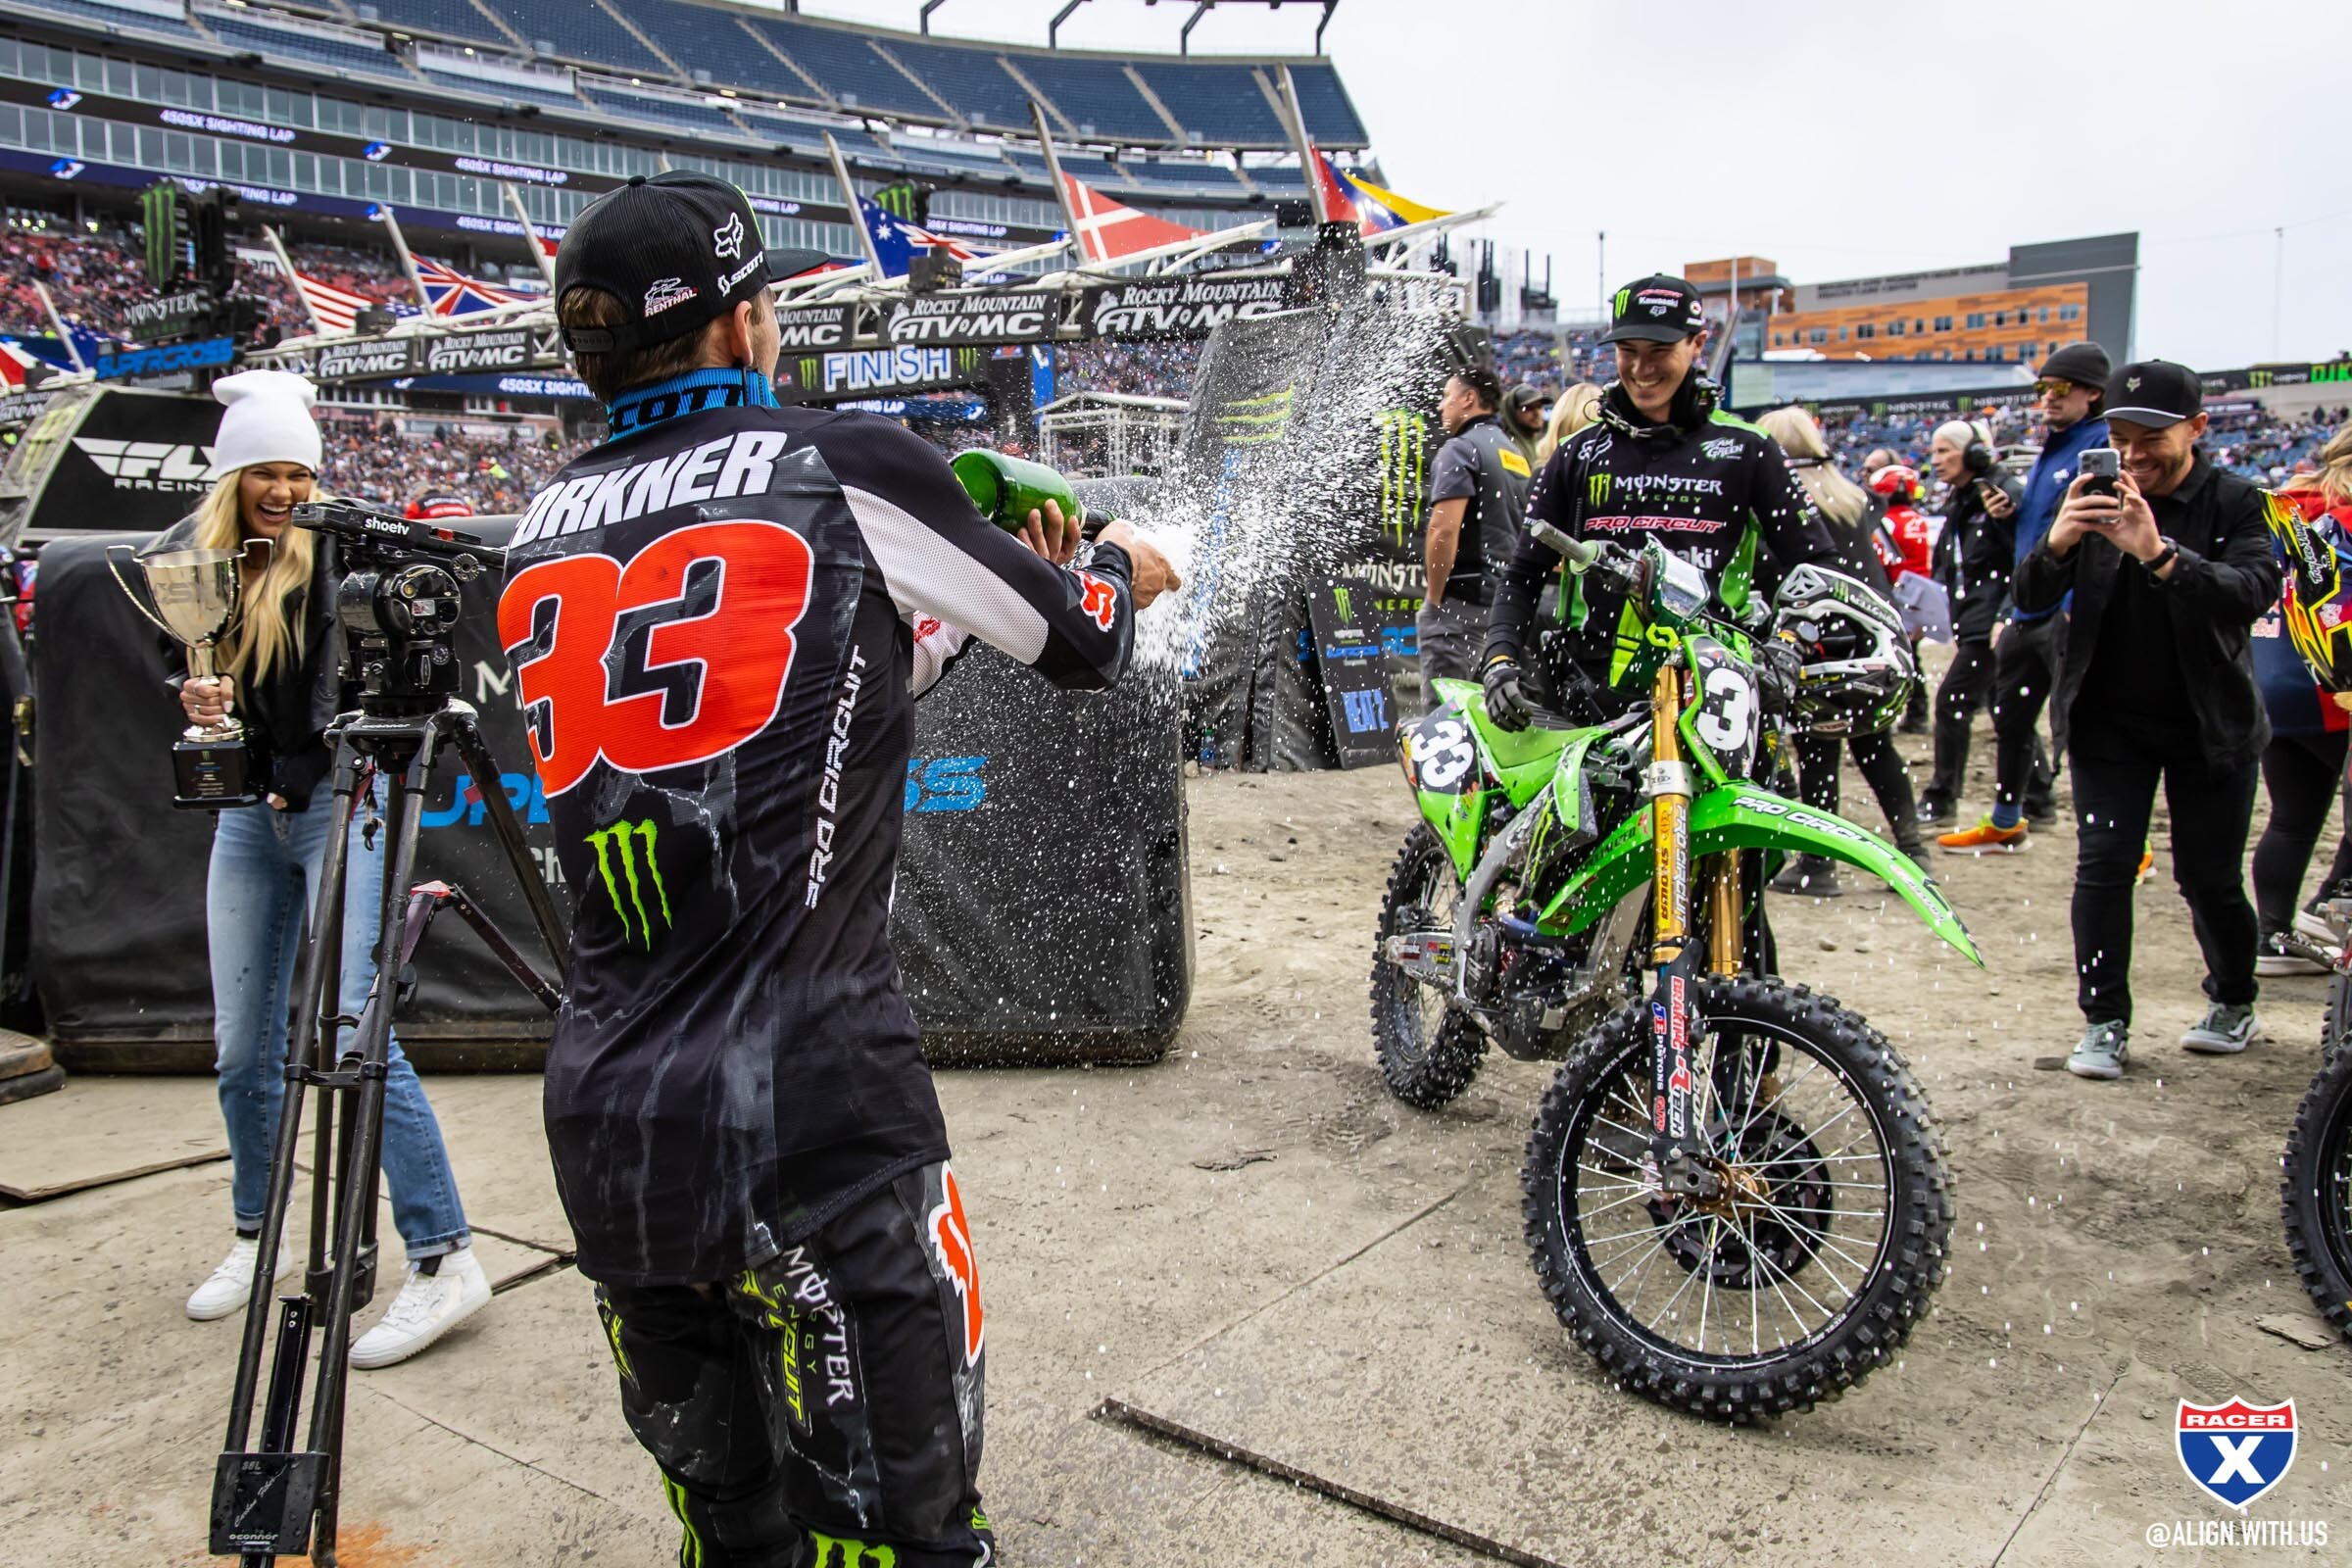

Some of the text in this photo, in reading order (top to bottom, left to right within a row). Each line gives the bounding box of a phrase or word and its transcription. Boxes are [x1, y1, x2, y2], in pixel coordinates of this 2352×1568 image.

[160, 109, 296, 143] 450SX SIGHTING LAP
[491, 162, 545, 182] SIGHTING
[545, 170, 568, 184] LAP
[270, 190, 298, 206] LAP
[780, 203, 801, 215] LAP
[948, 221, 989, 236] SIGHTING
[989, 225, 1008, 238] LAP
[644, 289, 698, 318] RENTHAL
[1121, 279, 1285, 306] ROCKY MOUNTAIN
[123, 292, 199, 326] MONSTER
[912, 294, 1048, 317] ROCKY MOUNTAIN
[332, 339, 408, 358] ROCKY MOUNTAIN
[444, 331, 526, 351] ROCKY MOUNTAIN
[824, 345, 952, 392] FINISH
[499, 377, 544, 394] 450SX
[885, 400, 906, 413] LAP
[1615, 474, 1723, 496] MONSTER
[365, 516, 410, 535] shoetv
[1584, 516, 1723, 533] PRO CIRCUIT
[497, 517, 815, 800] 33
[818, 644, 866, 813] CIRCUIT
[1410, 720, 1474, 788] 33
[1732, 795, 1897, 860] PRO CIRCUIT
[1673, 804, 1688, 930] PRO CIRCUIT
[1671, 976, 1685, 1051] BRAKING
[1656, 1035, 1666, 1091] PISTONS
